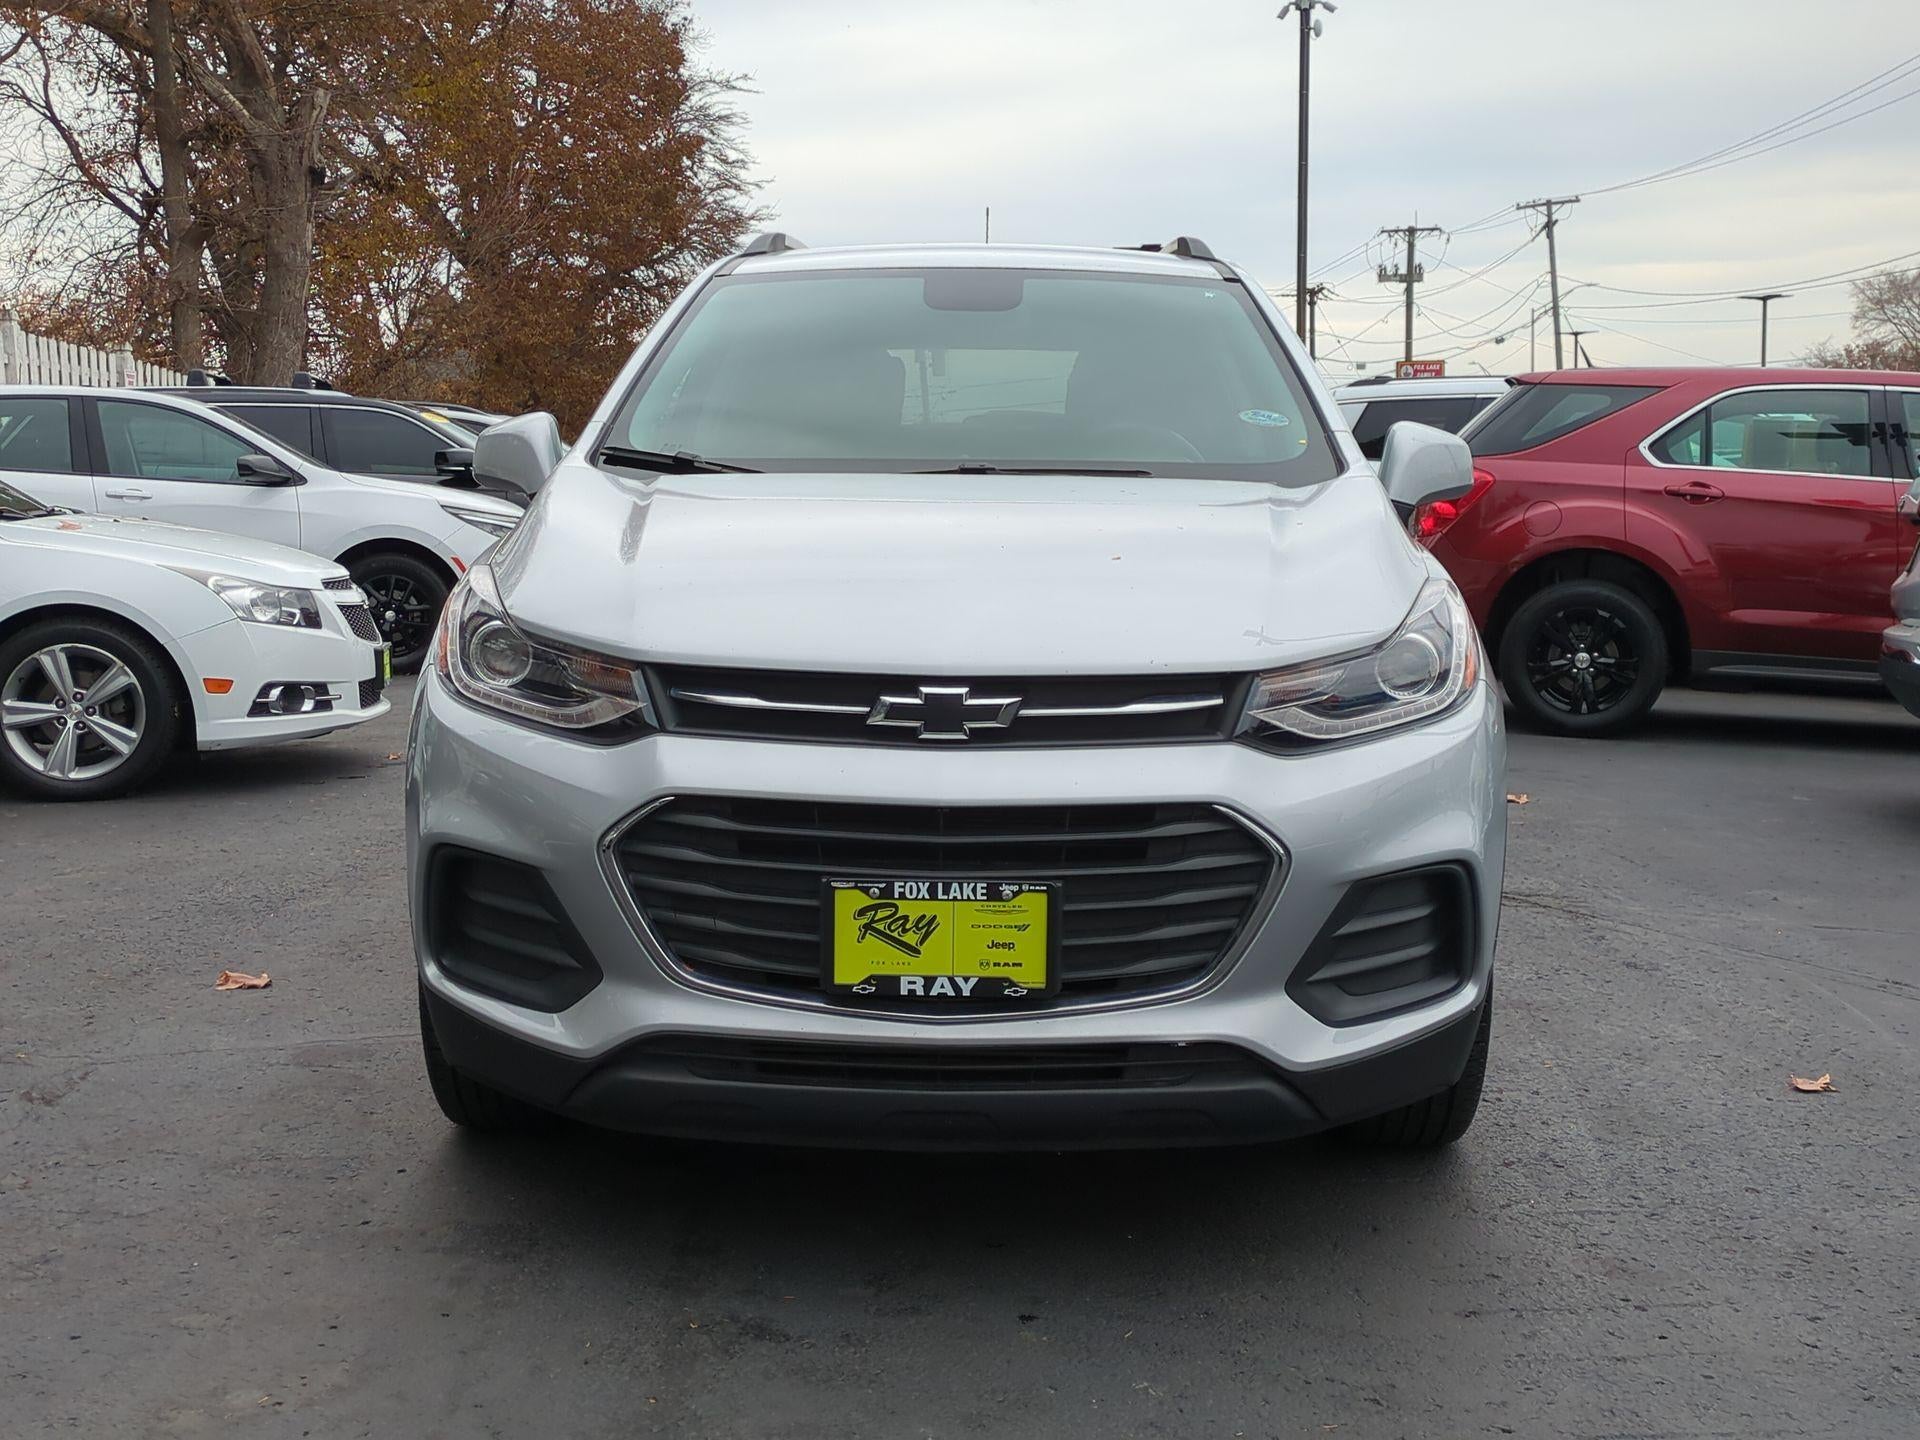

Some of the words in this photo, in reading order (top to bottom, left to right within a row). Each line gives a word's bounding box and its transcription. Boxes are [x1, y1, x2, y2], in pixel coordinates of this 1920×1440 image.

[894, 881, 930, 899] FOX
[938, 882, 988, 900] LAKE
[999, 883, 1020, 893] Jeep
[853, 902, 941, 958] Ray
[986, 939, 1016, 952] Jeep
[900, 976, 980, 997] RAY
